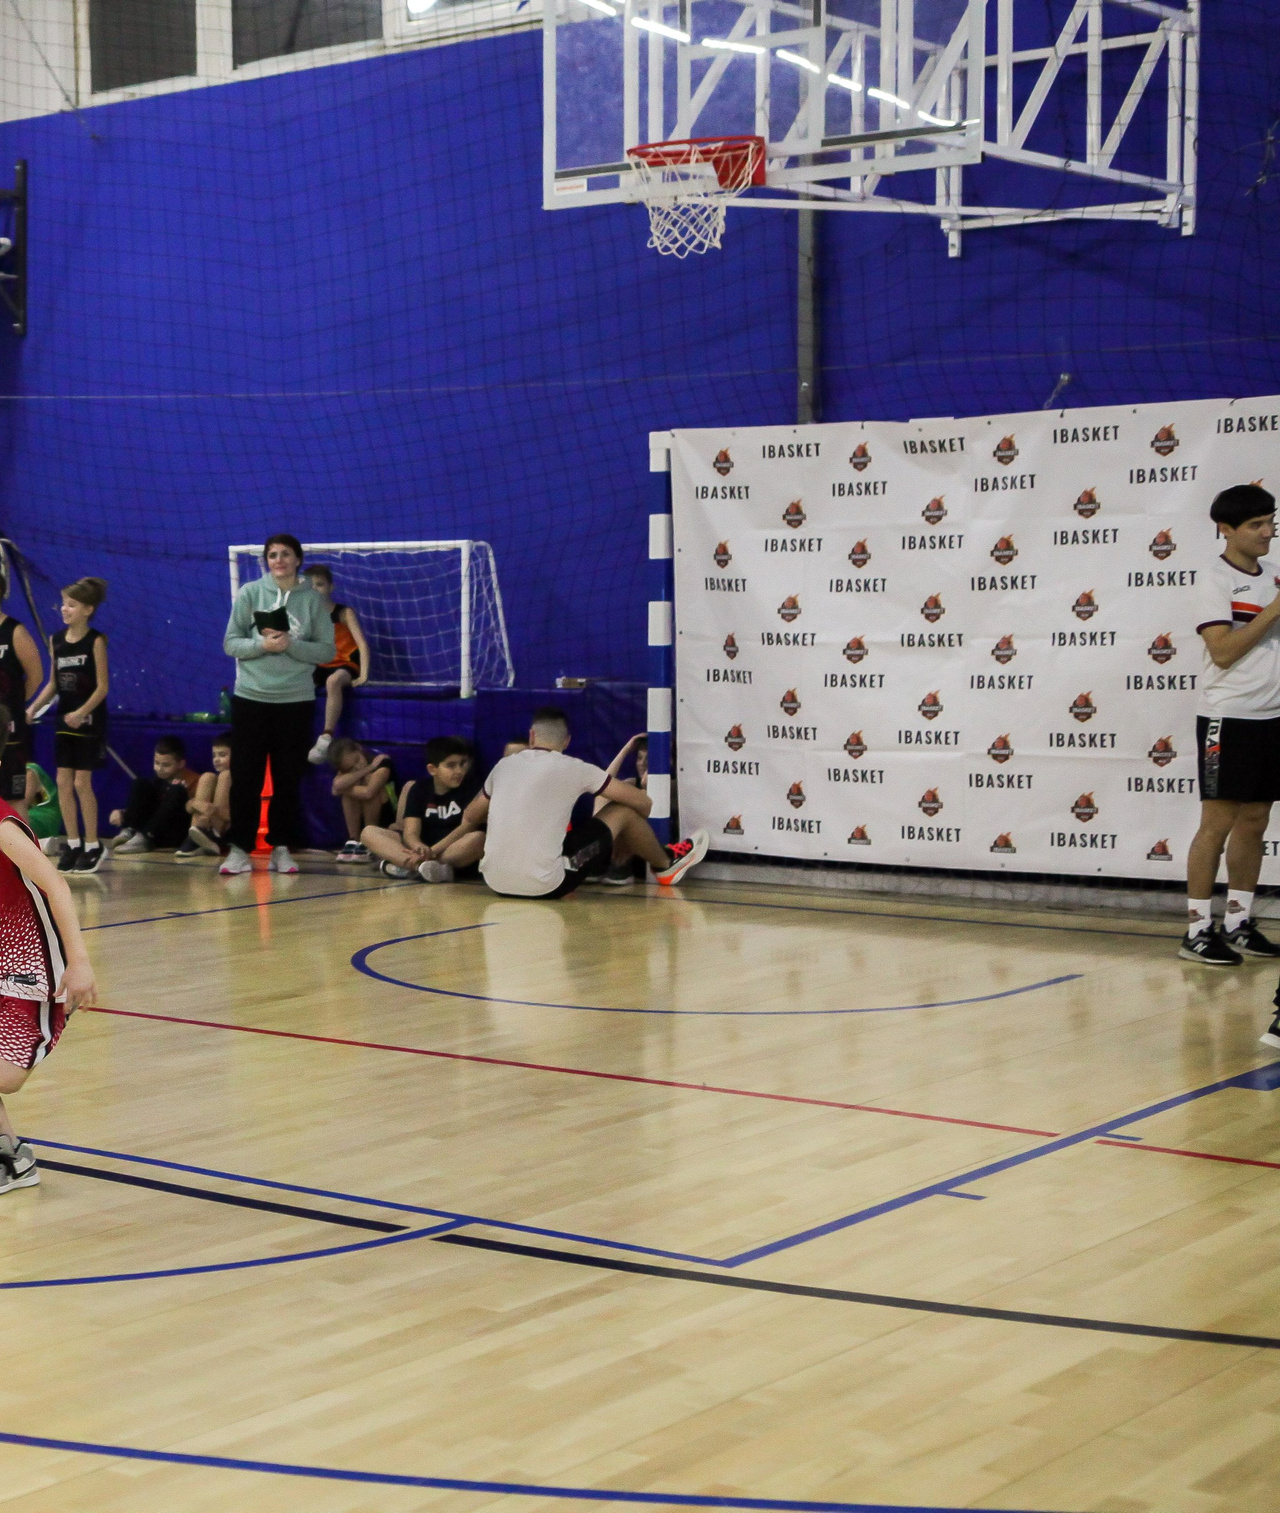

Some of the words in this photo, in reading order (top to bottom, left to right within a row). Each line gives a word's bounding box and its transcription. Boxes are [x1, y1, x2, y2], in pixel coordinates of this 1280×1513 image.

[1052, 425, 1120, 444] IBASKET
[762, 442, 821, 459] IBASKET
[902, 436, 965, 455] IBASKET
[974, 473, 1036, 493] IBASKET
[1129, 465, 1198, 485] IBASKET
[695, 485, 750, 500] IBASKET
[831, 480, 888, 498] IBASKET
[764, 537, 823, 553] IBASKET
[901, 534, 964, 551] IBASKET
[1053, 528, 1119, 546] IBASKET
[704, 577, 747, 593] IBASKET
[829, 577, 887, 593] IBASKET
[970, 574, 1037, 592] IBASKET
[1127, 570, 1198, 588] IBASKET
[761, 631, 817, 647] IBASKET
[900, 633, 964, 648] IBASKET
[1051, 630, 1117, 647] IBASKET
[706, 668, 753, 685] IBASKET
[824, 673, 885, 689] IBASKET
[970, 674, 1034, 690] IBASKET
[1126, 674, 1198, 691] IBASKET
[766, 724, 818, 741] IBASKET
[898, 729, 961, 746] IBASKET
[1049, 732, 1117, 749] IBASKET
[706, 759, 760, 776] IBASKET
[827, 767, 885, 784] IBASKET
[968, 773, 1034, 790] IBASKET
[1126, 776, 1197, 795] IBASKET
[424, 800, 462, 820] FILA
[771, 815, 822, 834] IBASKET
[901, 825, 962, 843] IBASKET
[1050, 831, 1118, 850] IBASKET
